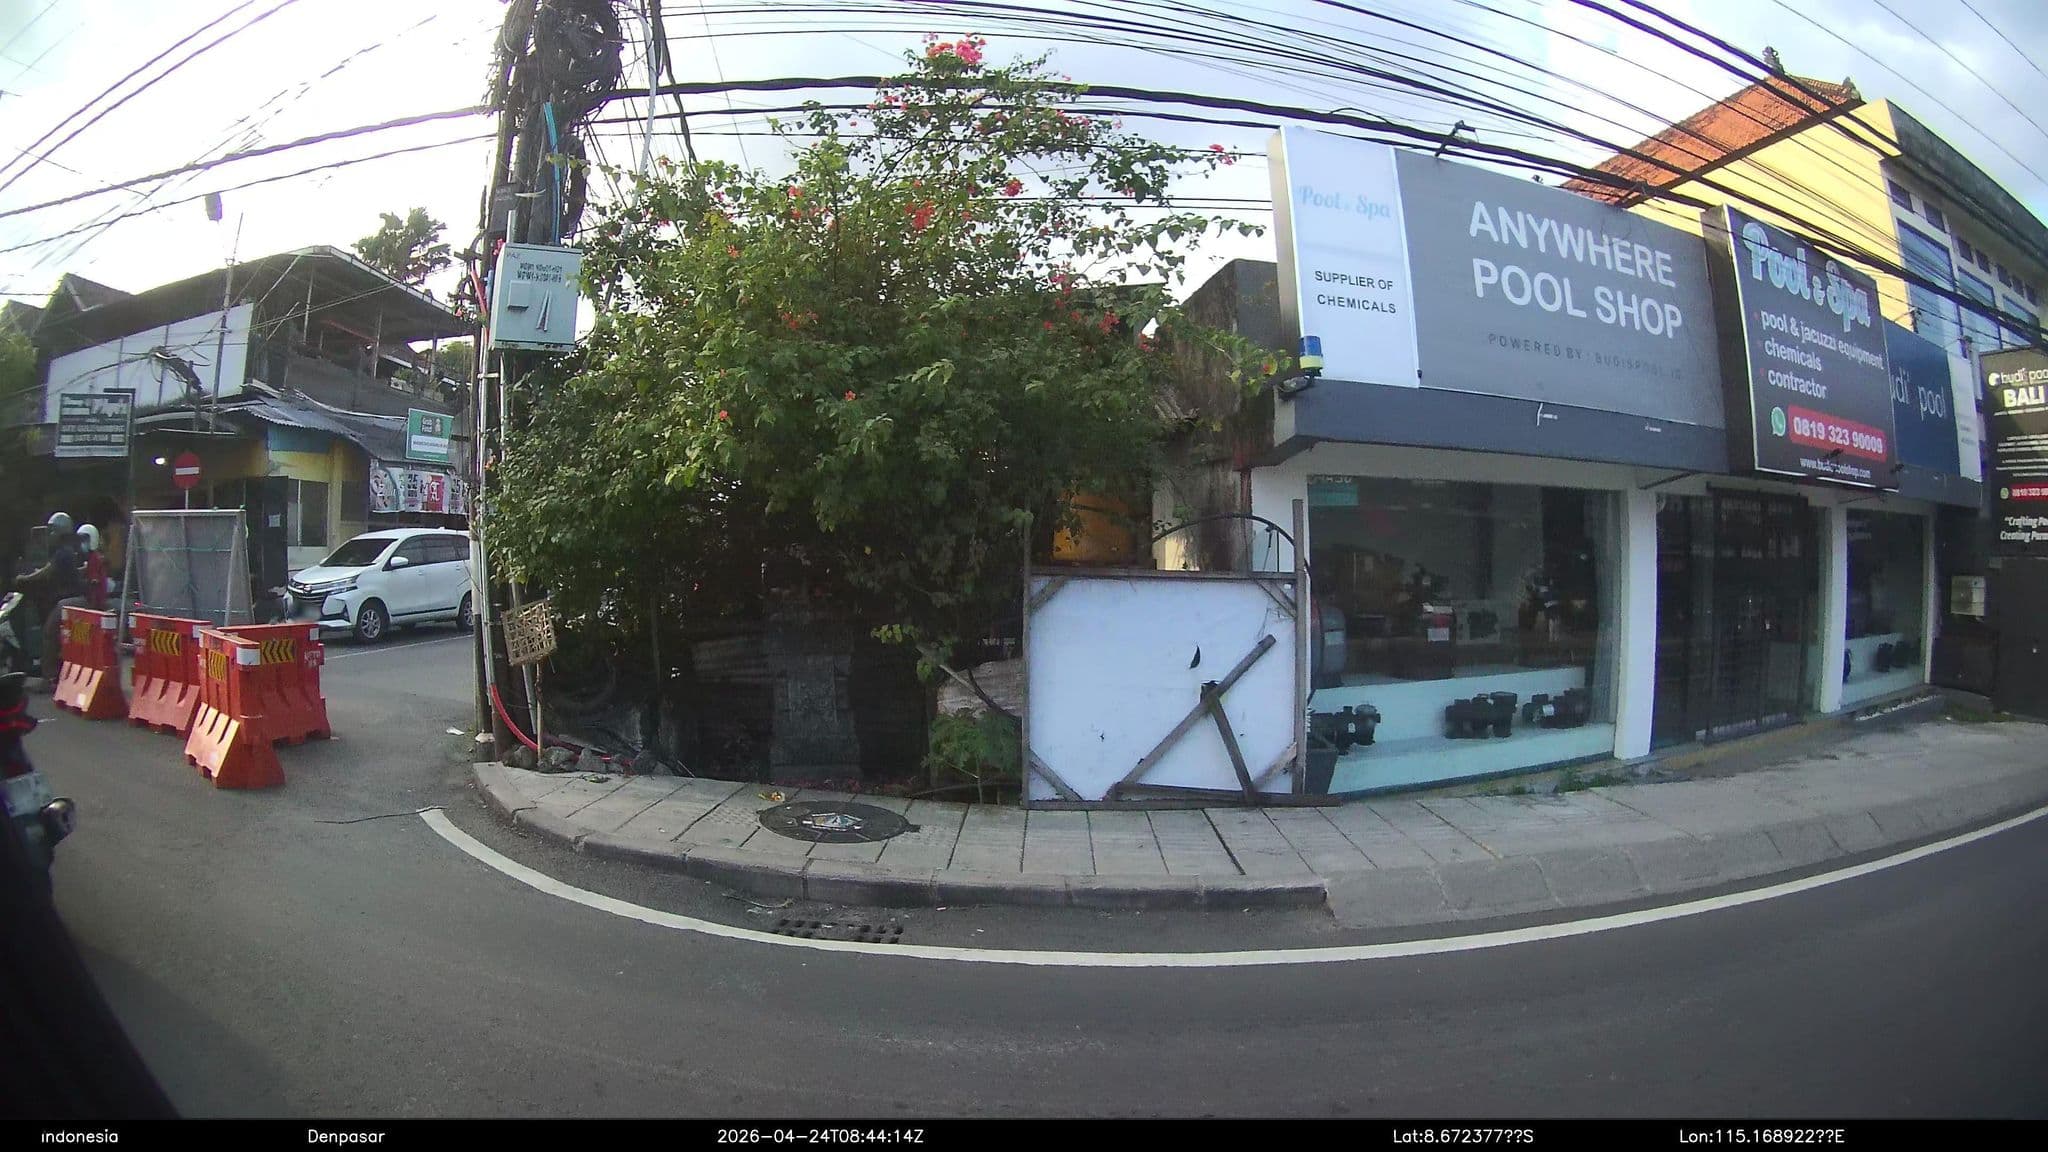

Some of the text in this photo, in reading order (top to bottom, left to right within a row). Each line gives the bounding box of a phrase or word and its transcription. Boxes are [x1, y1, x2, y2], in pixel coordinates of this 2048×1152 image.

[1298, 185, 1342, 210] Pool
[1356, 194, 1391, 221] Spa
[1469, 201, 1676, 288] ANYWHERE
[1314, 270, 1394, 291] SUPPLIER OF
[1742, 222, 1811, 300] Pool
[1825, 260, 1871, 332] Spa
[1316, 294, 1397, 314] CHEMICALS
[1473, 257, 1683, 339] POOL SHOP
[1488, 333, 1561, 357] POWERED
[1761, 310, 1885, 370] pool & jacuzzi equipment
[1764, 337, 1822, 372] chemicals
[1767, 369, 1828, 400] contractor
[2028, 369, 2048, 385] poo
[1917, 384, 1947, 421] pool
[2003, 385, 2046, 408] BALI
[1792, 416, 1883, 454] 0819 323 90009
